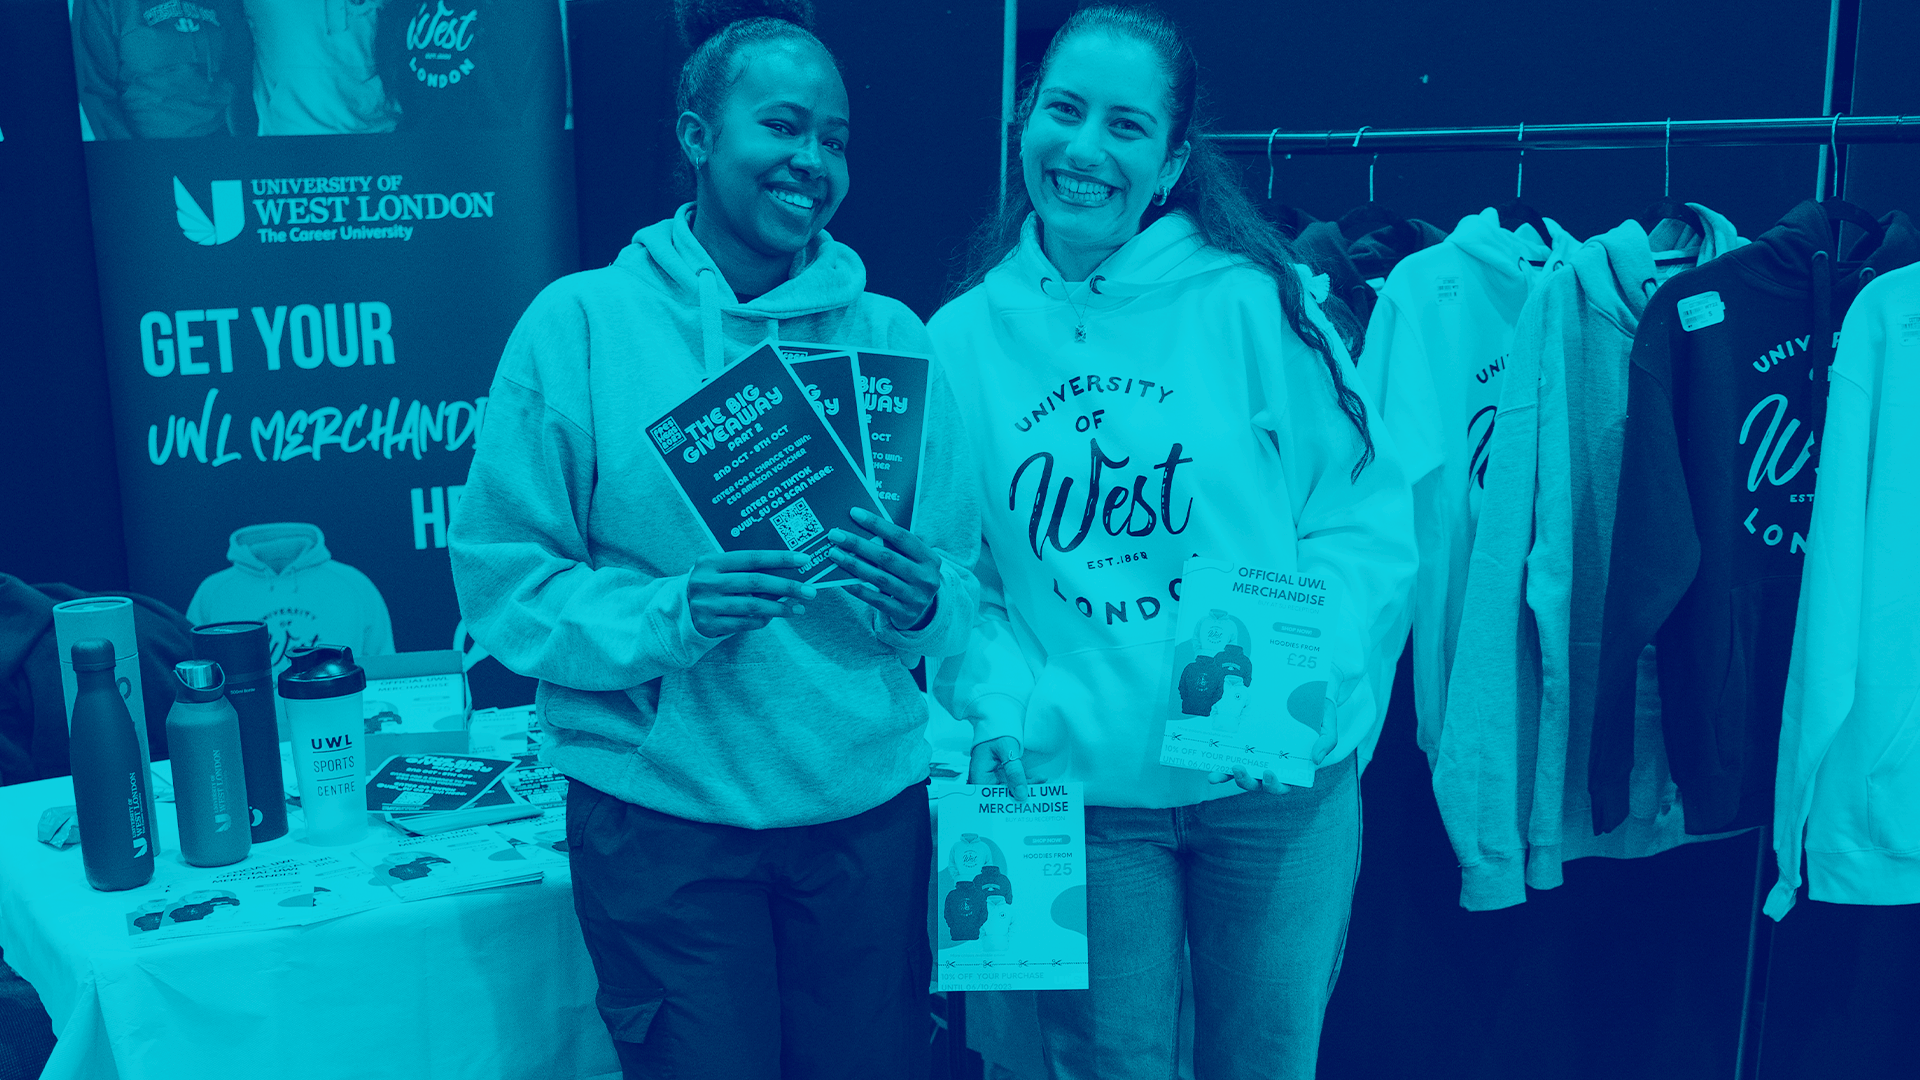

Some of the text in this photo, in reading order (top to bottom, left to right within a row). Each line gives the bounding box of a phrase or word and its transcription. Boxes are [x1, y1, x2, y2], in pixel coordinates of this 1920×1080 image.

[406, 0, 478, 52] West
[409, 56, 475, 89] LONDON
[251, 175, 404, 197] UNIVERSITY OF
[252, 191, 496, 226] WEST LONDON
[257, 224, 414, 244] The Career University
[139, 301, 397, 378] GET YOUR
[684, 384, 760, 441] THE BIG
[1014, 374, 1174, 433] UNIVERSITY
[148, 387, 243, 468] UWL
[683, 386, 783, 464] GIVEAWAY
[1075, 409, 1105, 433] OF
[727, 422, 764, 452] PART 2
[871, 432, 892, 442] OCT
[713, 465, 732, 482] 2ND
[731, 452, 750, 468] OCT
[770, 424, 789, 441] OCT
[872, 452, 884, 460] TO
[711, 485, 736, 505] ENTER
[734, 475, 750, 490] FOR
[748, 471, 756, 480] A
[754, 450, 785, 475] CHANCE
[783, 444, 796, 456] TO
[741, 469, 774, 496] AMAZON
[771, 448, 808, 475] VOUCHER
[740, 465, 812, 517] ENTER ON TIKTOK
[770, 496, 786, 509] OR
[783, 481, 809, 501] SCAN
[806, 465, 835, 486] HERE:
[1008, 437, 1194, 561] West
[1237, 566, 1327, 591] OFFICIAL UWL
[1053, 576, 1183, 626] LONDO
[1232, 582, 1326, 607] MERCHANDISE
[1287, 604, 1320, 615] RECEPTION
[1280, 625, 1296, 633] SHOP
[1269, 638, 1321, 653] HOODIES FROM
[1286, 652, 1318, 670] £25
[378, 682, 450, 692] MERCHANDISE
[310, 733, 353, 751] UWL
[212, 749, 223, 786] LONDON
[313, 755, 355, 774] SPORTS
[1162, 755, 1186, 766] UNTIL
[1164, 744, 1270, 769] 10% OFF YOUR PURCHASE
[317, 781, 356, 797] CENTRE
[981, 785, 1069, 798] OFFIL UWL
[129, 771, 143, 837] WEST LONDON
[978, 801, 1069, 814] MERCHANDISE
[212, 871, 301, 884] MERCHANDISE
[1042, 863, 1073, 877] £25
[941, 973, 956, 981] 10%
[1001, 971, 1045, 979] PURCHASE
